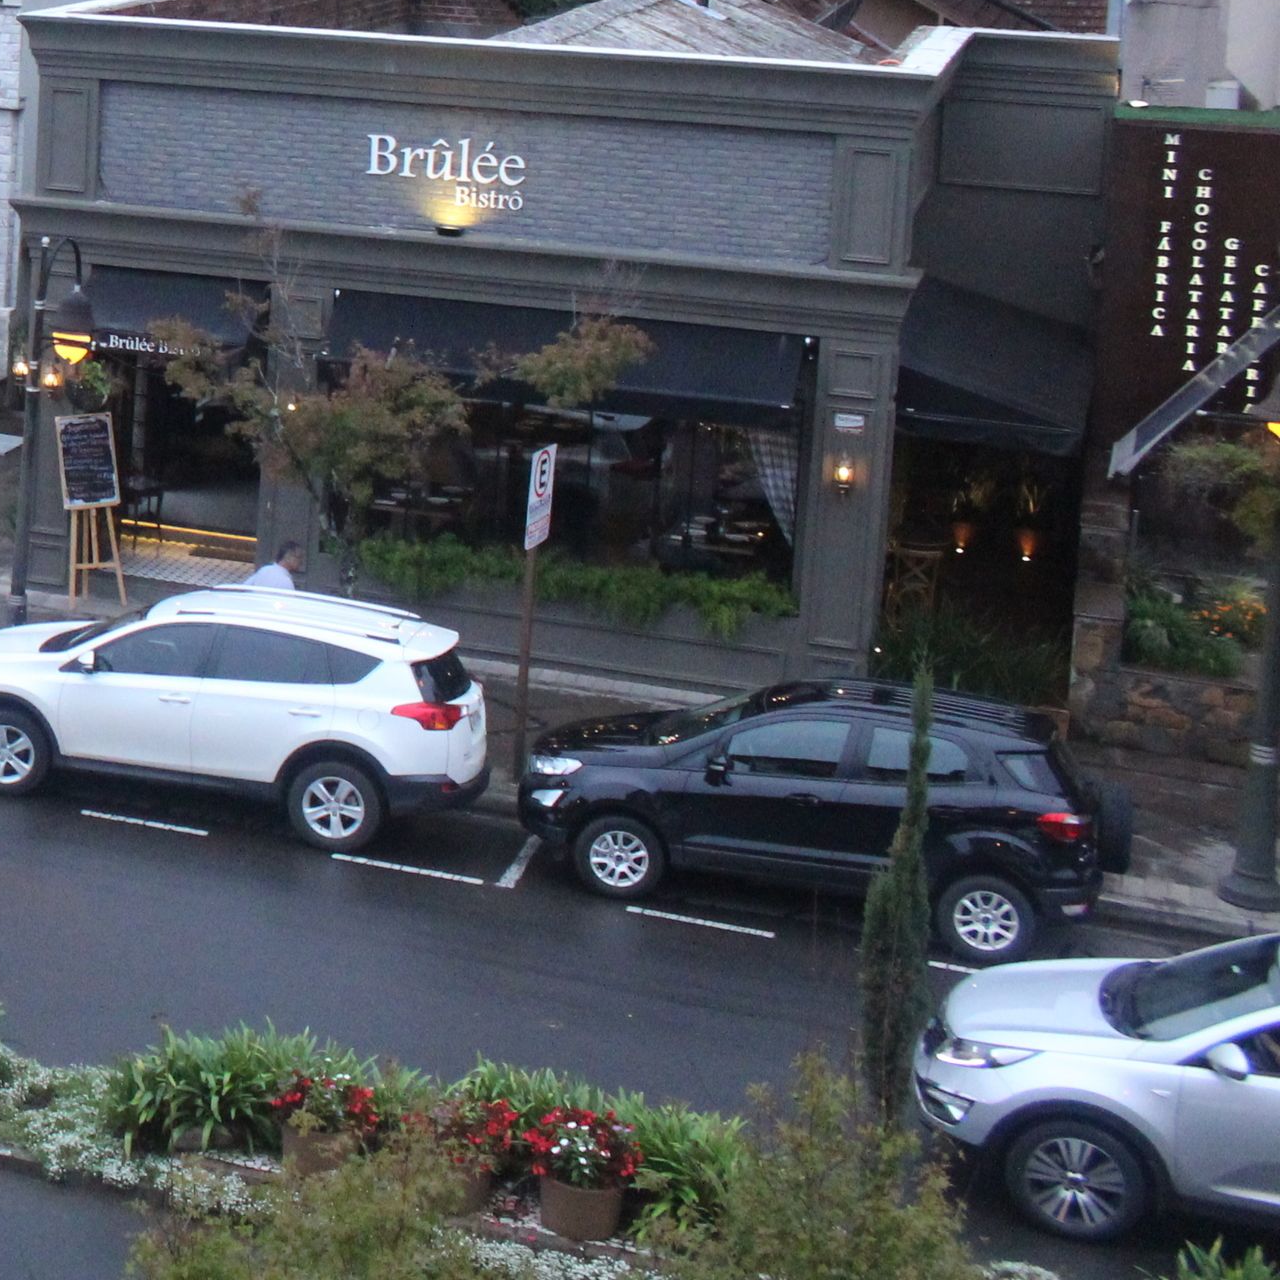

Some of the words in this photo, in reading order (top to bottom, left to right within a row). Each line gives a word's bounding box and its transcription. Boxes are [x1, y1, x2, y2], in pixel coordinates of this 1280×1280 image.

[365, 134, 526, 186] Brûlée
[1162, 133, 1181, 199] MINI
[454, 186, 523, 210] Bistrô
[1150, 221, 1172, 337] FÁBRICA
[1182, 168, 1212, 372] CHOCOLATARIA
[1215, 237, 1240, 388] GELATAR
[109, 334, 155, 353] Brûlée
[539, 458, 547, 489] E
